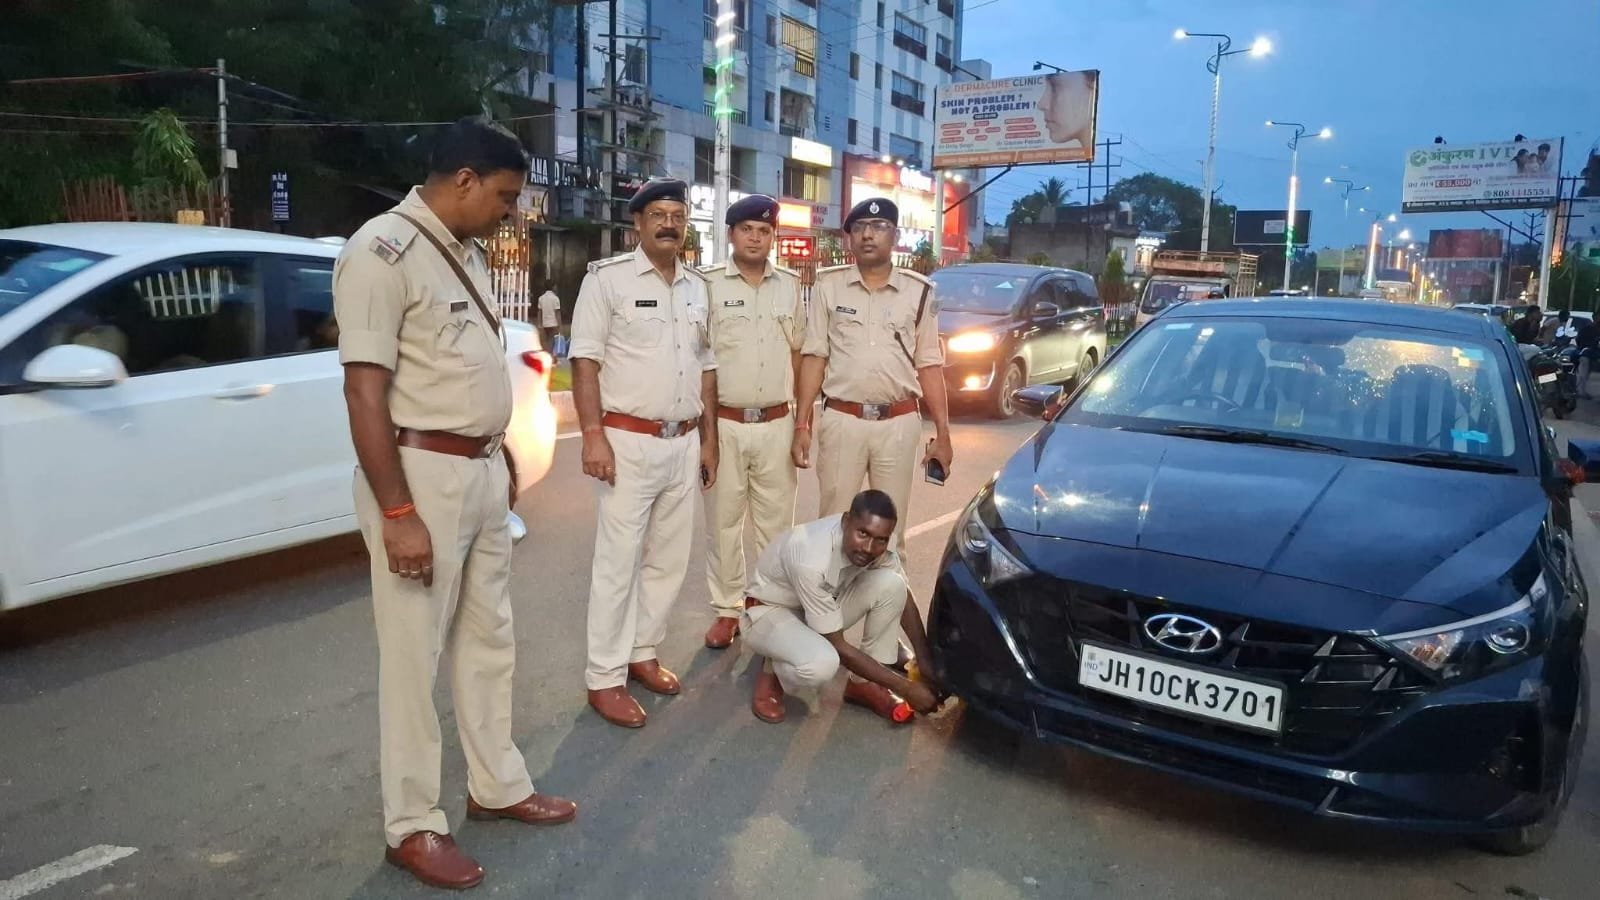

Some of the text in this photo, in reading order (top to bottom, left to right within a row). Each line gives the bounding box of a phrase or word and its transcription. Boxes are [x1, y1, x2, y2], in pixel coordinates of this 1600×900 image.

[954, 80, 1010, 93] DERMACURE
[1013, 77, 1043, 87] CLINIC
[941, 99, 964, 109] SKIN
[967, 94, 1015, 106] PROBLEM
[951, 106, 970, 115] NOT
[972, 105, 979, 114] A
[982, 101, 1030, 113] PROBLEM
[1099, 658, 1276, 722] JH10CK3701
